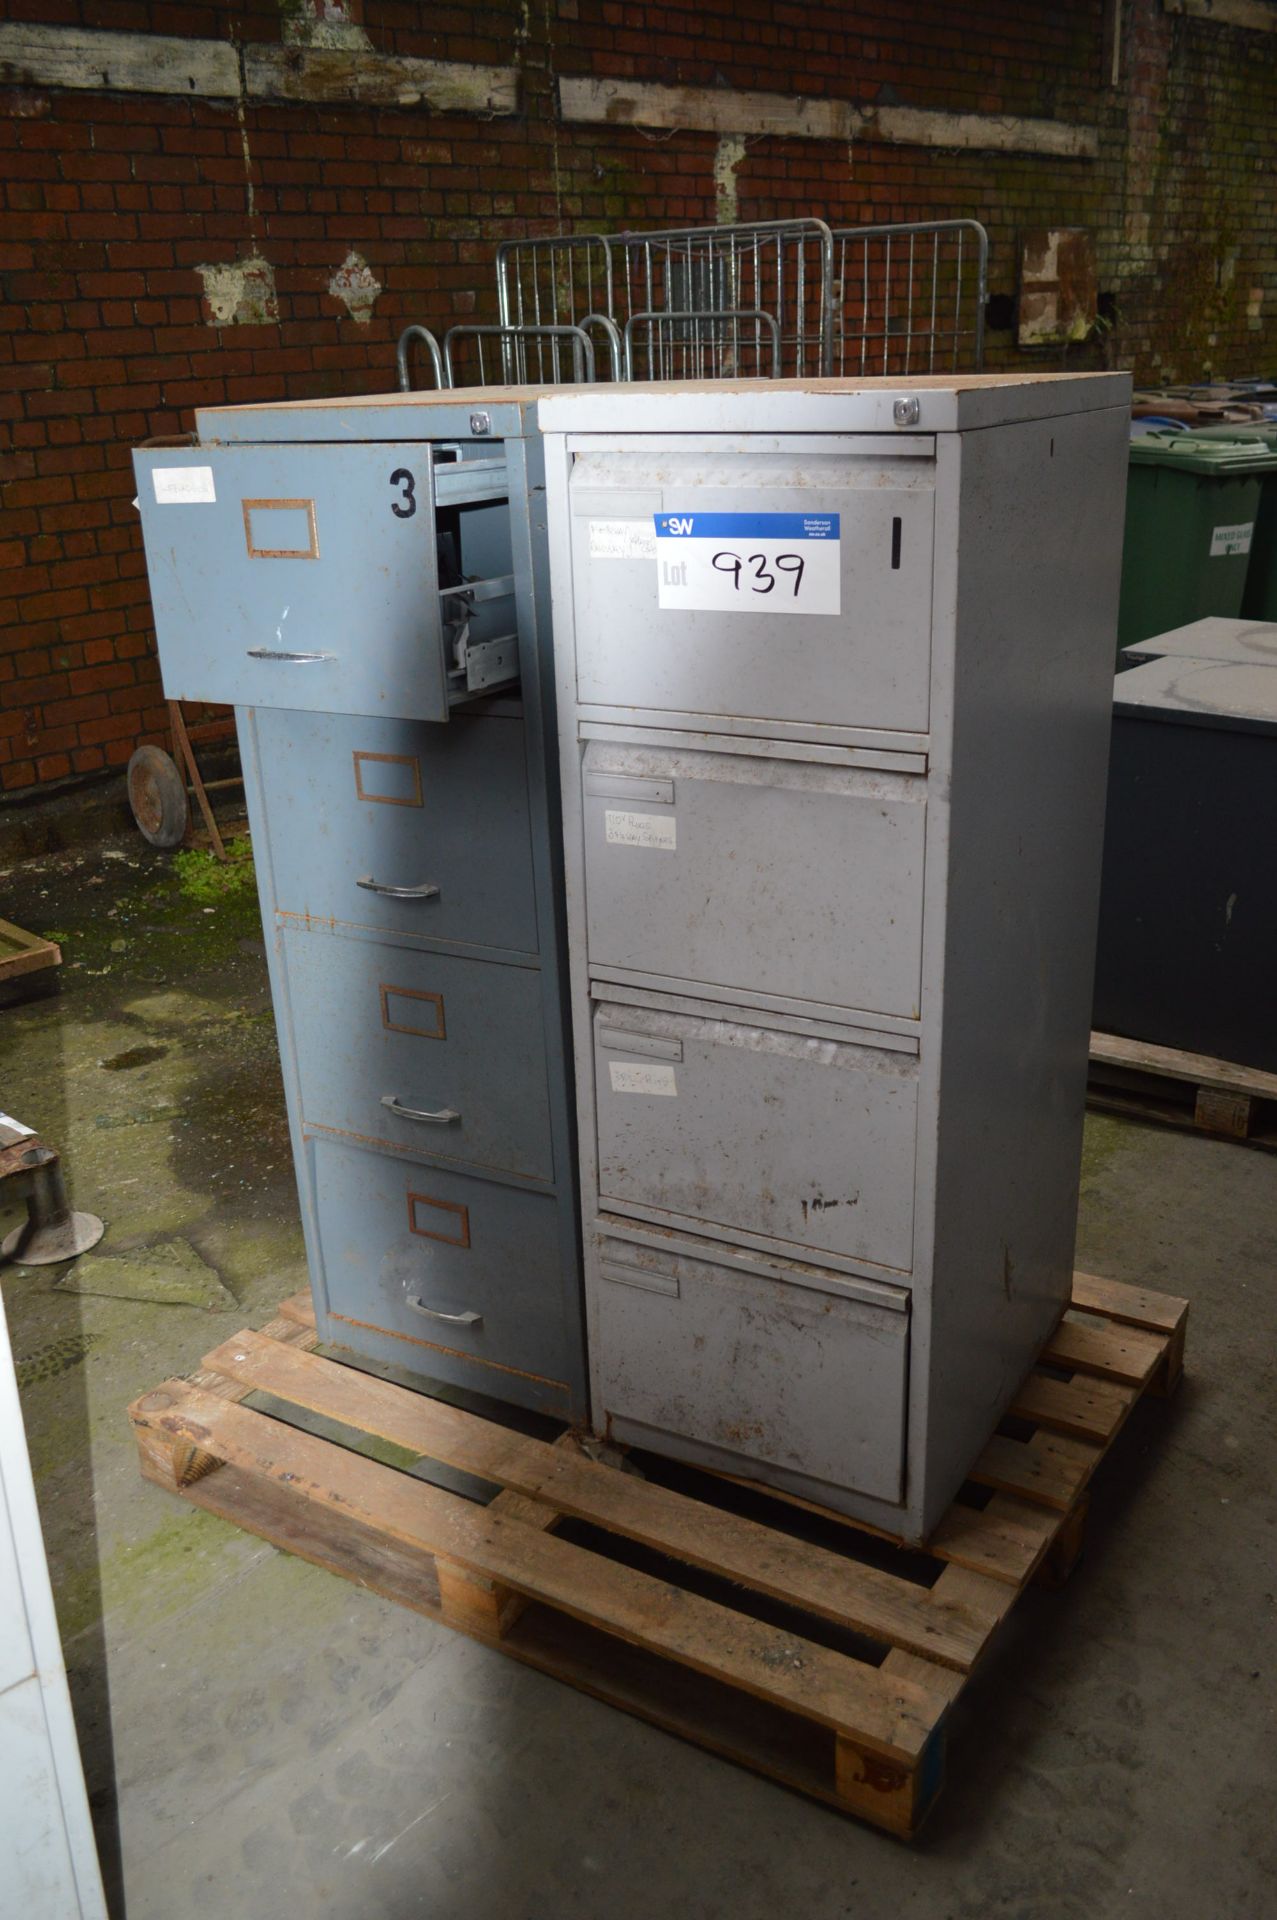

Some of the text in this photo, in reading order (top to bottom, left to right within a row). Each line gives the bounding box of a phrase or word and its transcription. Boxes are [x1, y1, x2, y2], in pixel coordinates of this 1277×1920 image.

[389, 467, 417, 518] 3
[669, 517, 694, 536] SW
[663, 560, 688, 587] Lot
[711, 551, 806, 597] 939
